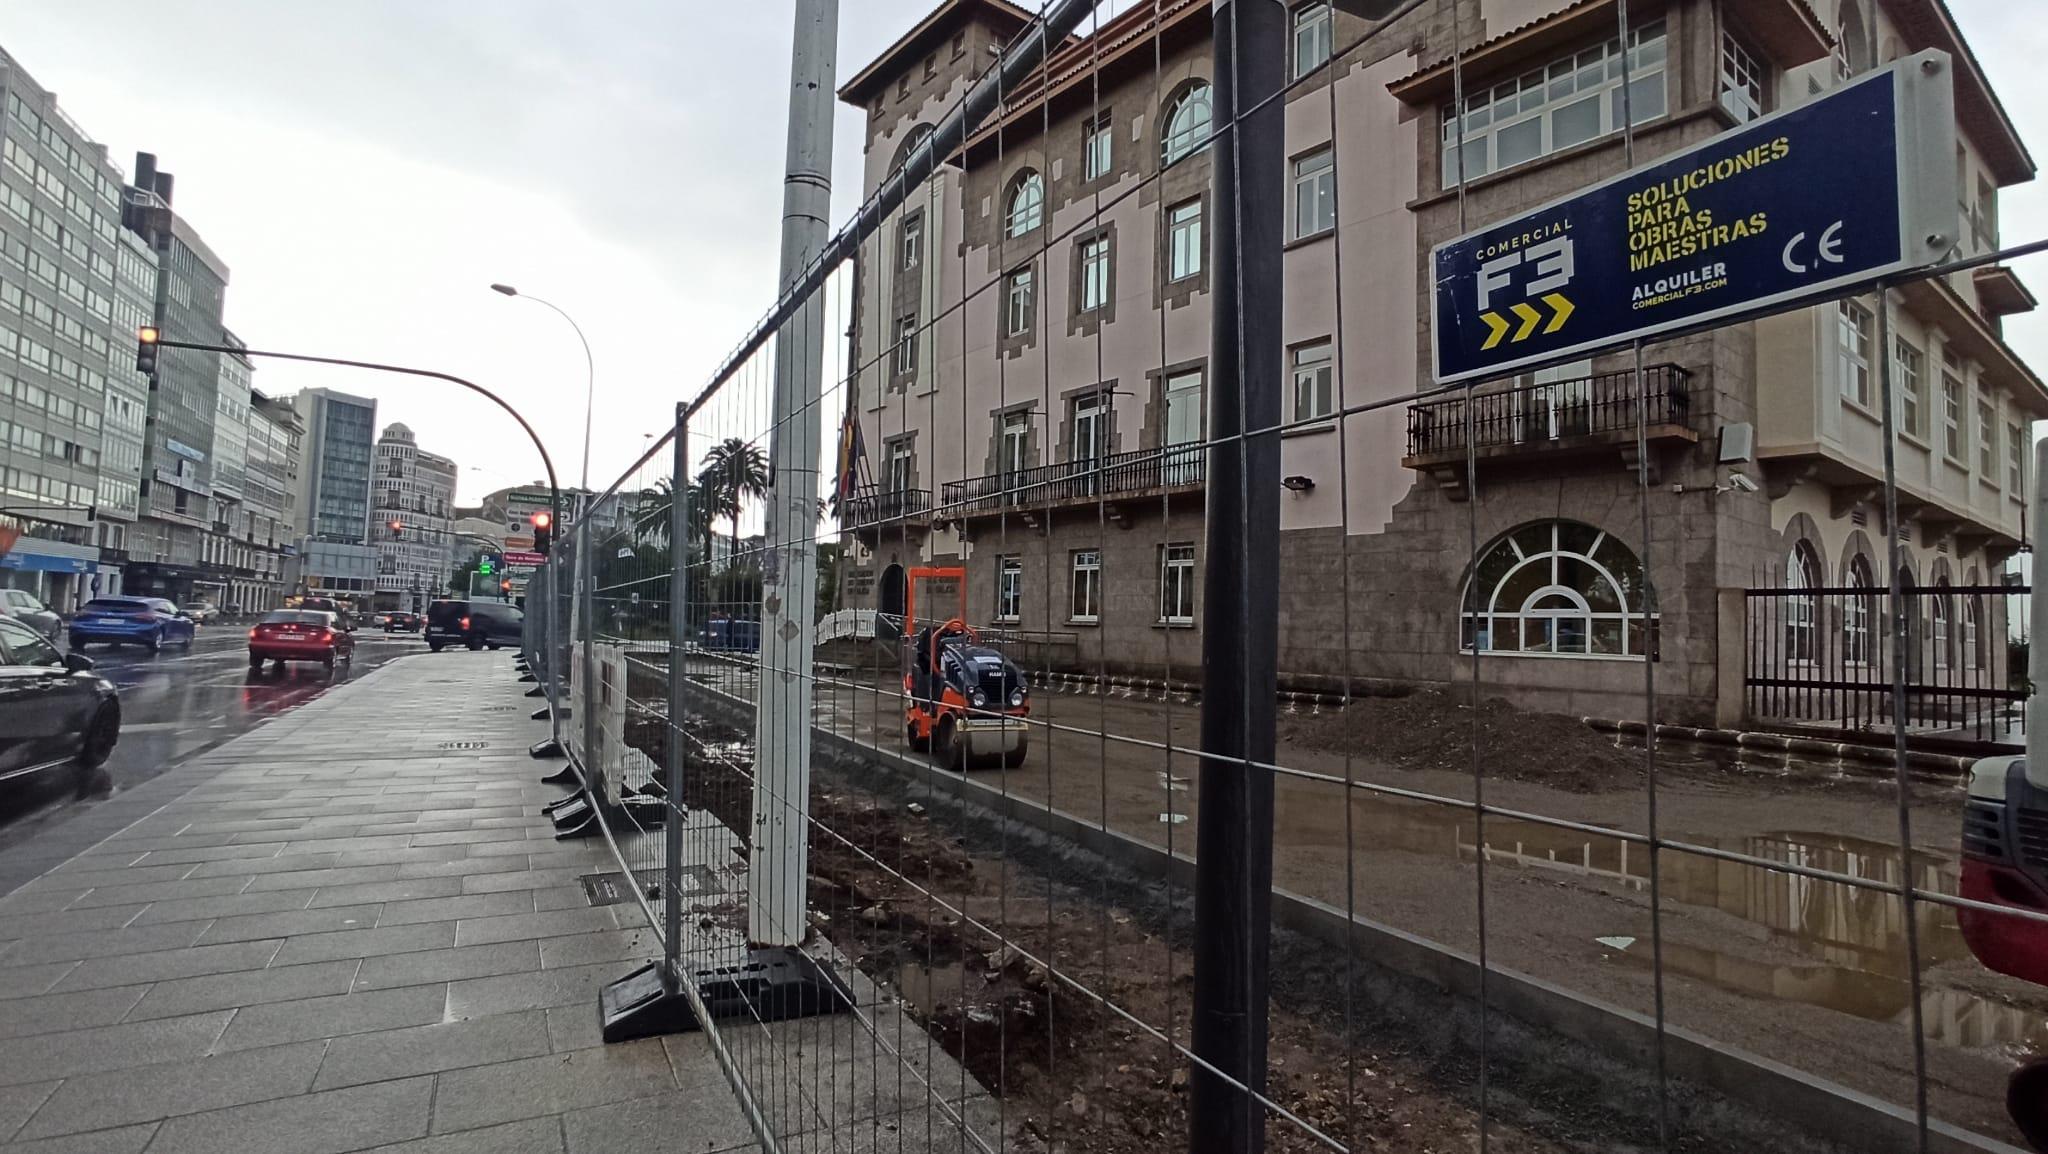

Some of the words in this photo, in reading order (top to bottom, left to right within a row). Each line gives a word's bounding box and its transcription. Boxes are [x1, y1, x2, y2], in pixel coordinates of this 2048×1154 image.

[1627, 136, 1790, 212] SOLUCIONES
[1628, 196, 1691, 233] PARA
[1629, 209, 1713, 251] OBRAS
[1475, 219, 1573, 260] COMERCIAL
[1630, 212, 1767, 272] MAESTRAS
[1782, 220, 1844, 273] CE
[1477, 235, 1574, 311] F3
[1632, 262, 1727, 301] ALQUILER
